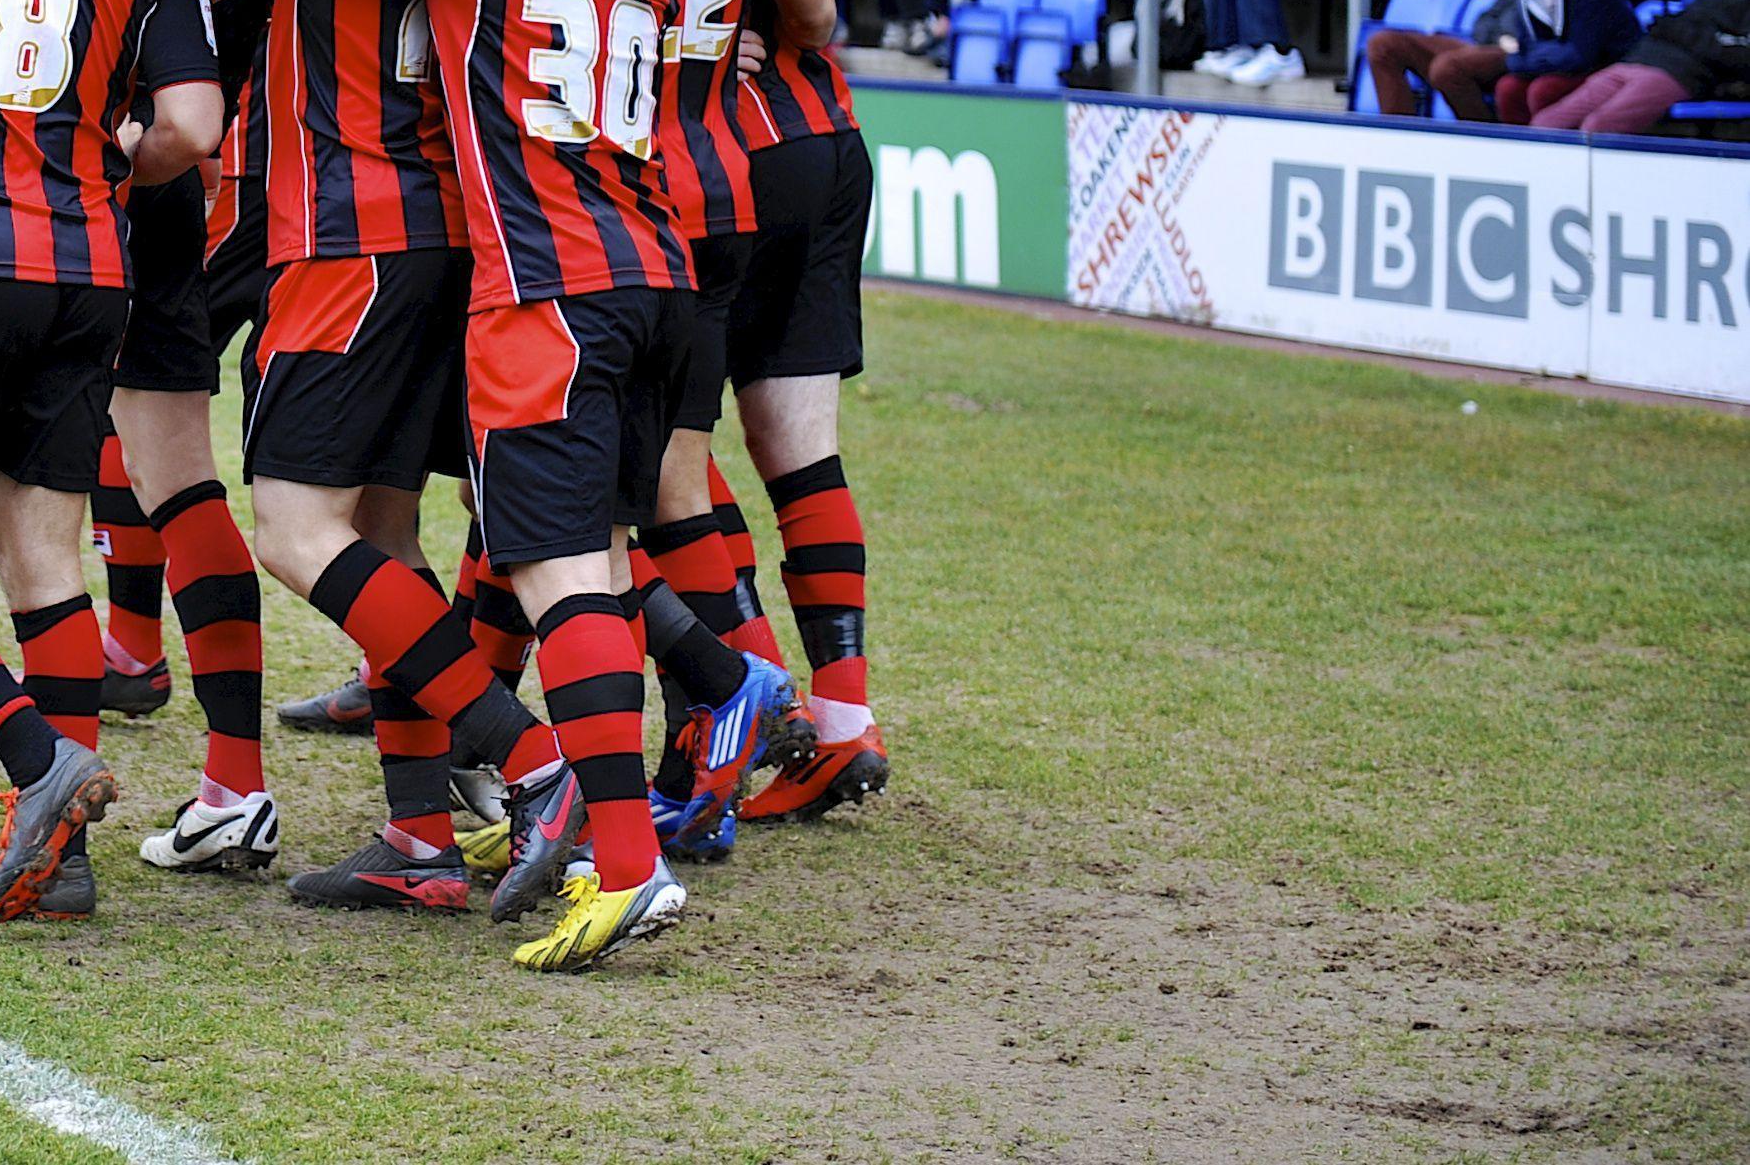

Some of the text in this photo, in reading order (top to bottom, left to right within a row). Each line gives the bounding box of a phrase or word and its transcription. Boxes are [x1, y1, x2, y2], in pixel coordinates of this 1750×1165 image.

[862, 143, 1001, 286] m
[1278, 171, 1522, 307] BBC
[1549, 205, 1750, 329] SHR
